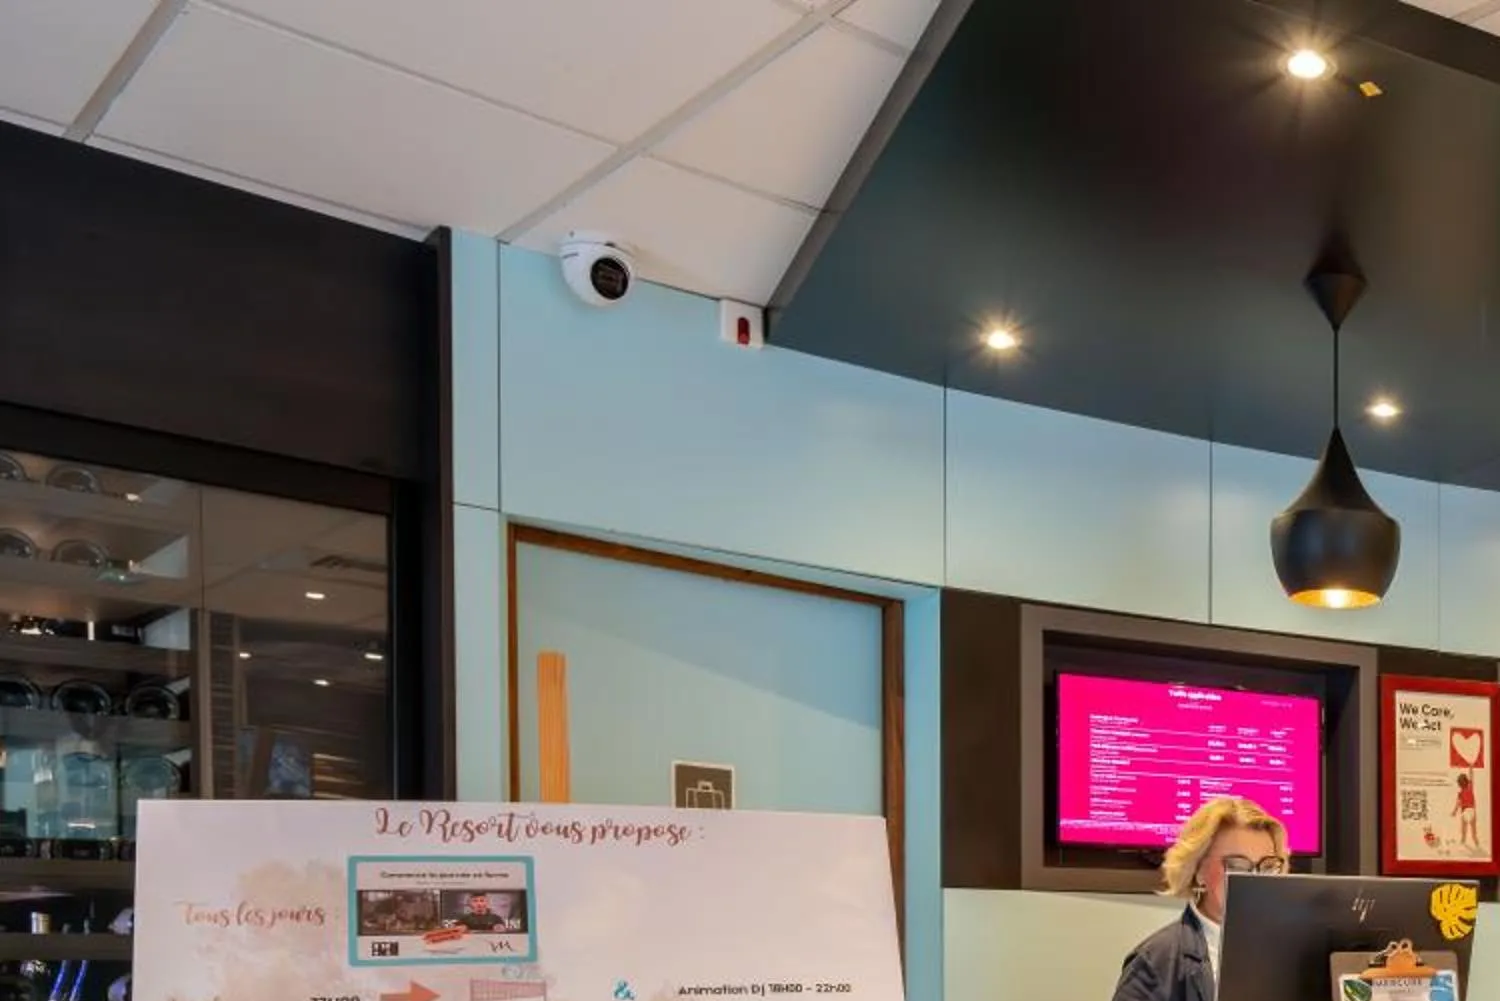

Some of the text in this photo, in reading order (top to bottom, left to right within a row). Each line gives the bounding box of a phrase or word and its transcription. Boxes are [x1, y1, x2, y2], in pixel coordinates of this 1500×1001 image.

[1400, 703, 1418, 716] We
[1399, 717, 1418, 730] We
[375, 807, 413, 837] Le
[419, 807, 523, 843] Resort
[525, 812, 585, 844] vous
[589, 818, 691, 847] propose
[678, 983, 749, 996] Animation
